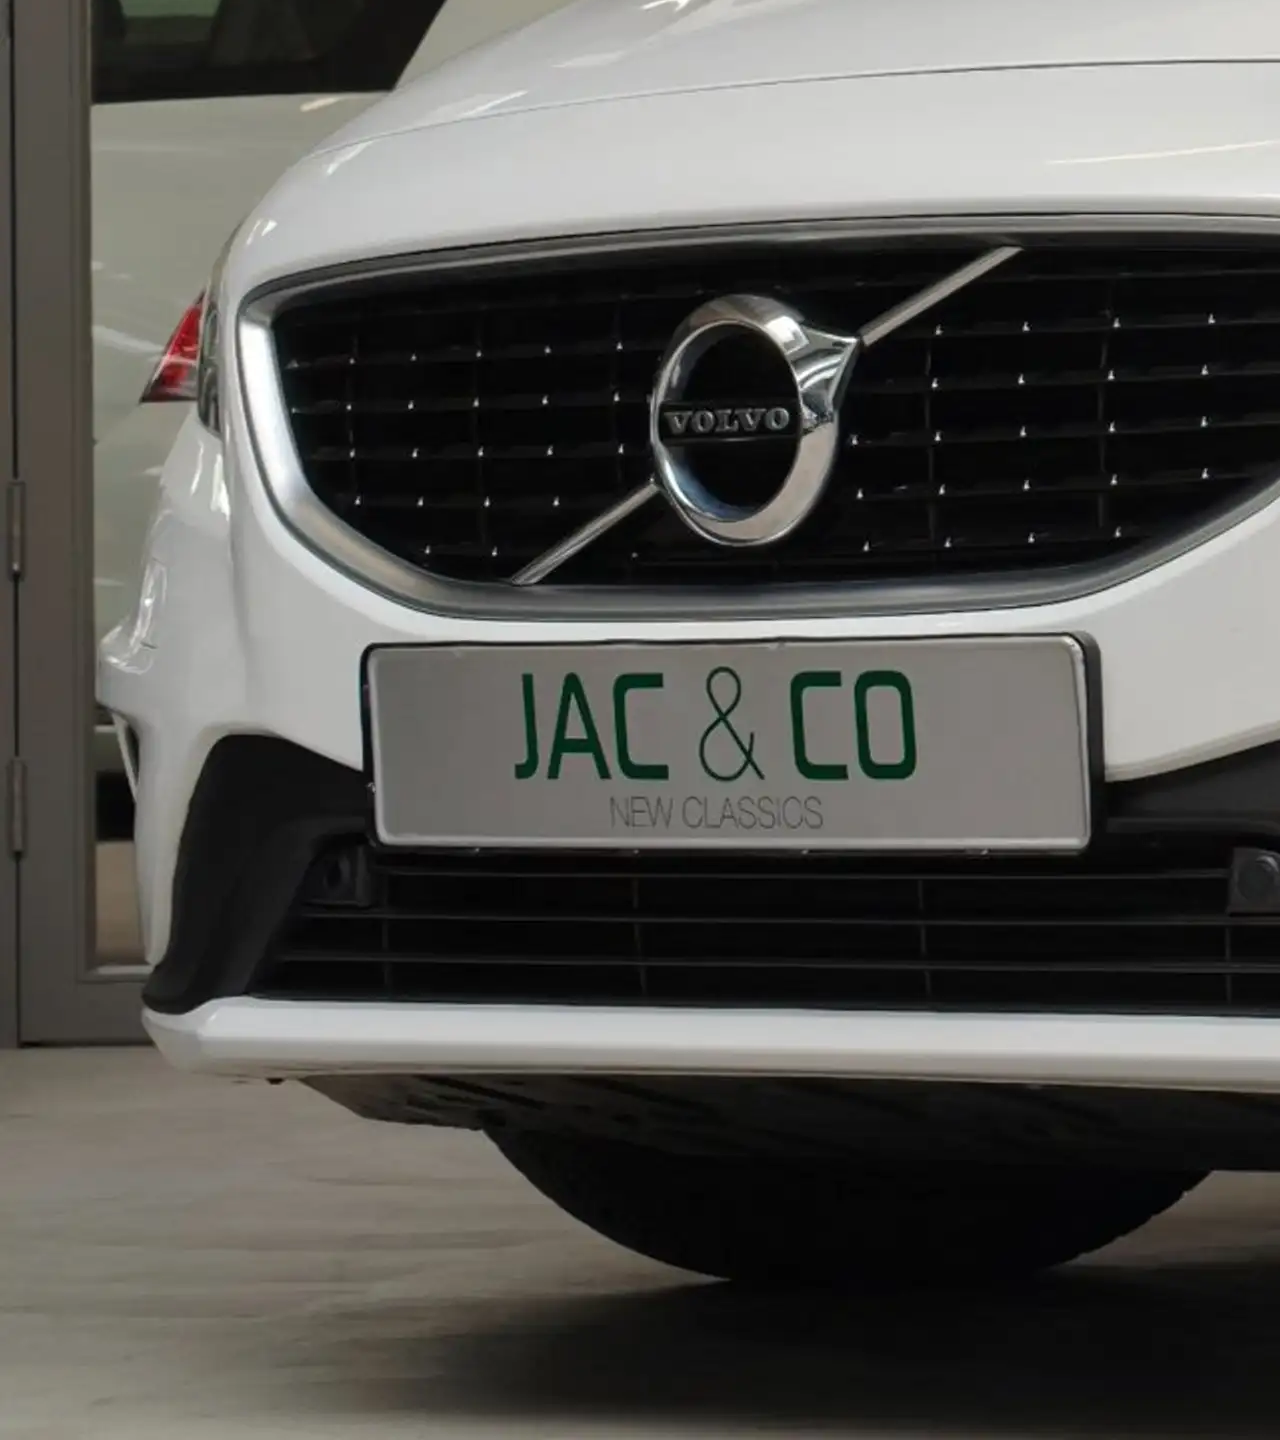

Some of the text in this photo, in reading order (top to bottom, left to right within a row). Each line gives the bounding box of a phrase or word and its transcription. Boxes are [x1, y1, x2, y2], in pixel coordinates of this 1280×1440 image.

[664, 407, 790, 434] VOLVO
[514, 666, 918, 782] JAC & CO
[609, 795, 824, 830] NEW CLASSICS
